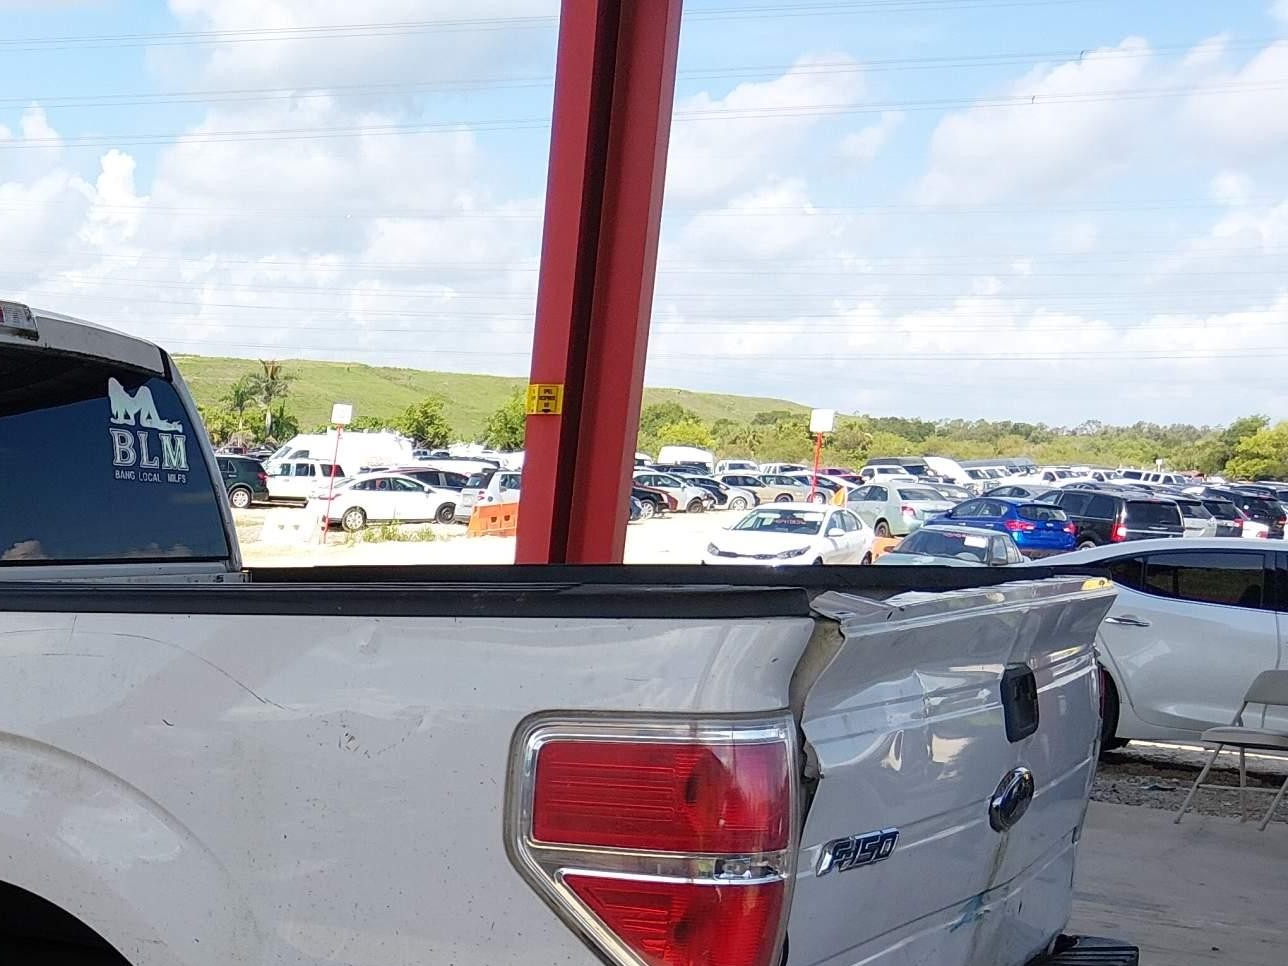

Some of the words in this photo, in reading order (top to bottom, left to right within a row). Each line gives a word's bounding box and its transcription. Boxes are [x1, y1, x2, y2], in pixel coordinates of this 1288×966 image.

[109, 427, 190, 471] BLM
[115, 469, 136, 480] BANG
[138, 471, 162, 482] LOCAL
